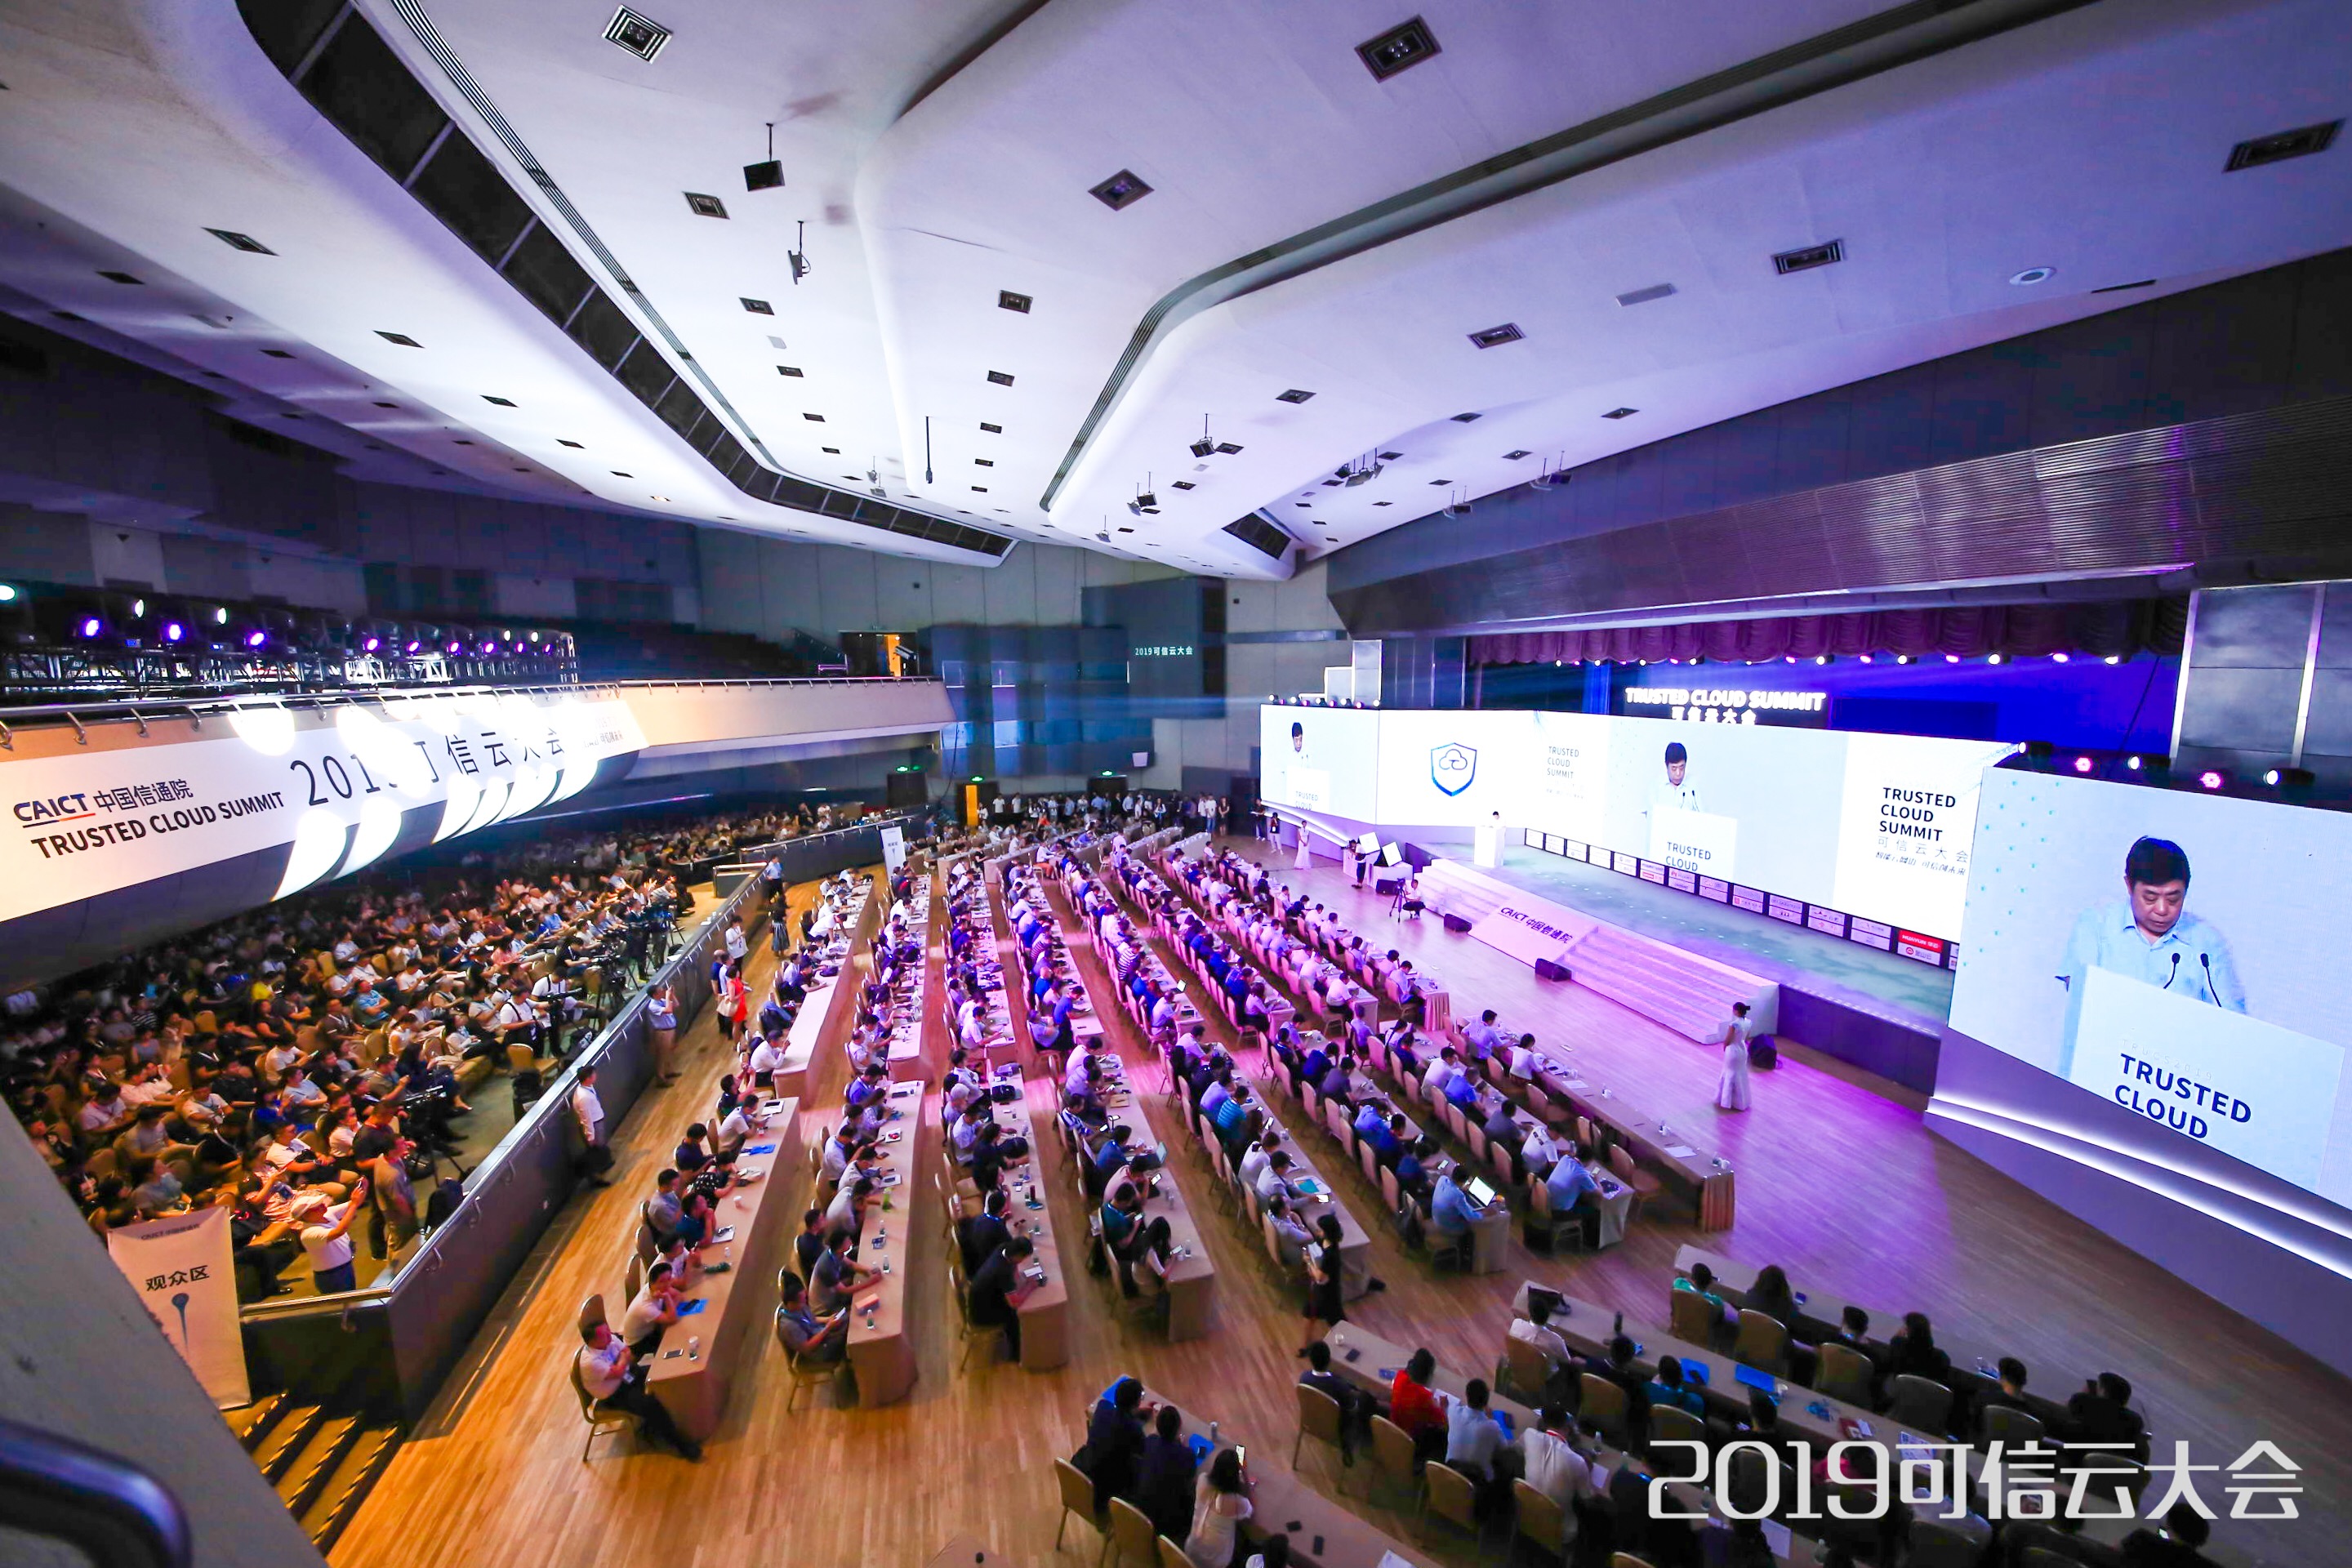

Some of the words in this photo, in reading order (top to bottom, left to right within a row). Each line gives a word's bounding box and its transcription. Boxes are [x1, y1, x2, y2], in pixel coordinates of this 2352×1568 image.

[1135, 646, 1192, 656] 2019可信云大会
[1625, 688, 1689, 705] TRUSTED
[1690, 689, 1747, 707] CLOUD
[1748, 691, 1826, 710] SUMMIT
[1548, 746, 1579, 757] TRUSTED
[1548, 757, 1570, 768] CLOUD
[1547, 768, 1574, 778] SUMMIT
[13, 793, 89, 822] CAICT
[92, 778, 194, 813] 中国信通院
[1295, 791, 1318, 801] TRUSTED
[1883, 787, 1956, 808] TRUSTED
[1881, 804, 1934, 822] CLOUD
[31, 820, 147, 858] TRUSTED
[149, 805, 216, 834] CLOUD
[219, 791, 285, 819] SUMMIT
[1879, 821, 1943, 841] SUMMIT
[1667, 841, 1711, 860] TRUSTED
[1878, 835, 1968, 863] 可信云大会
[1666, 856, 1698, 871] CLOUD
[1501, 907, 1528, 921] CAICT
[1526, 919, 1573, 943] 中国信通院
[2120, 1053, 2252, 1123] TRUSTED
[2114, 1085, 2207, 1138] CLOUD
[145, 1265, 209, 1291] 观众区
